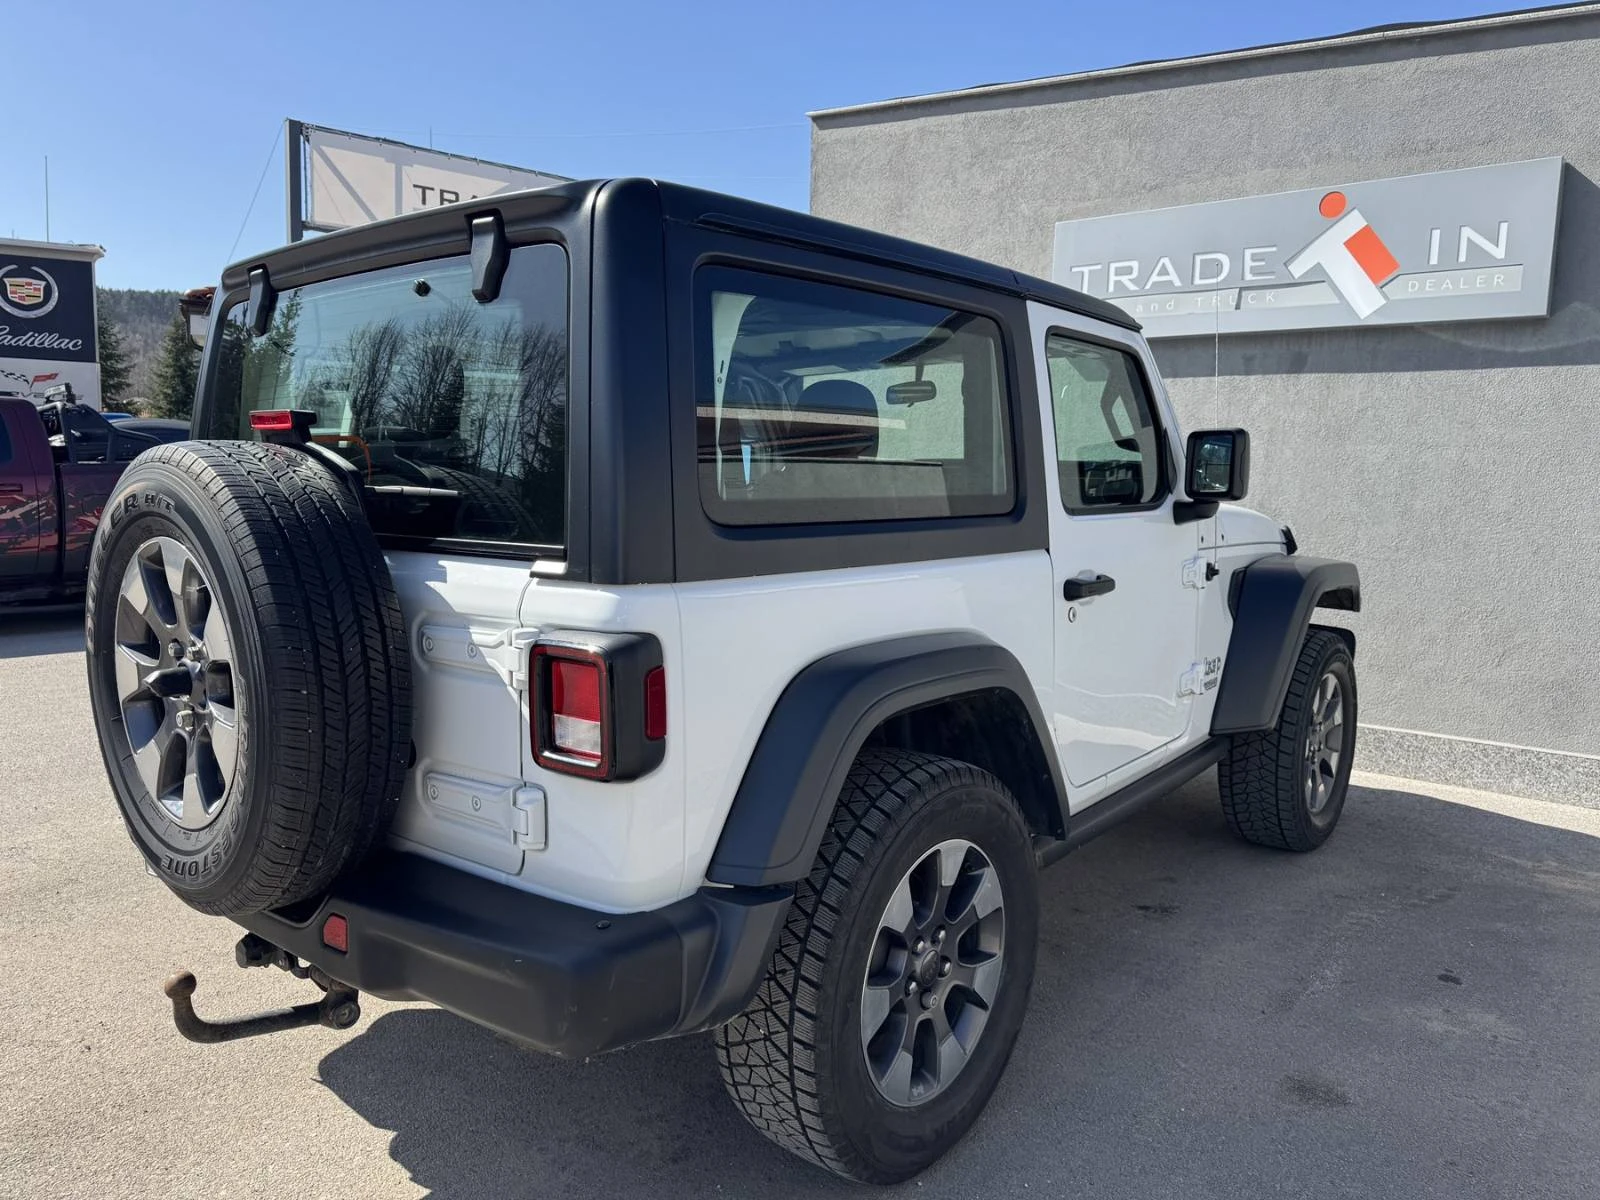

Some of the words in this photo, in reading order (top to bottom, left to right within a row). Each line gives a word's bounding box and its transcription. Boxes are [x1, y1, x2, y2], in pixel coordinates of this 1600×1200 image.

[413, 184, 478, 206] TR
[1071, 246, 1277, 294] TRADE
[1429, 221, 1508, 264] IN
[1135, 299, 1175, 312] and
[1195, 291, 1275, 307] TRUCK
[1408, 274, 1505, 292] DEALER
